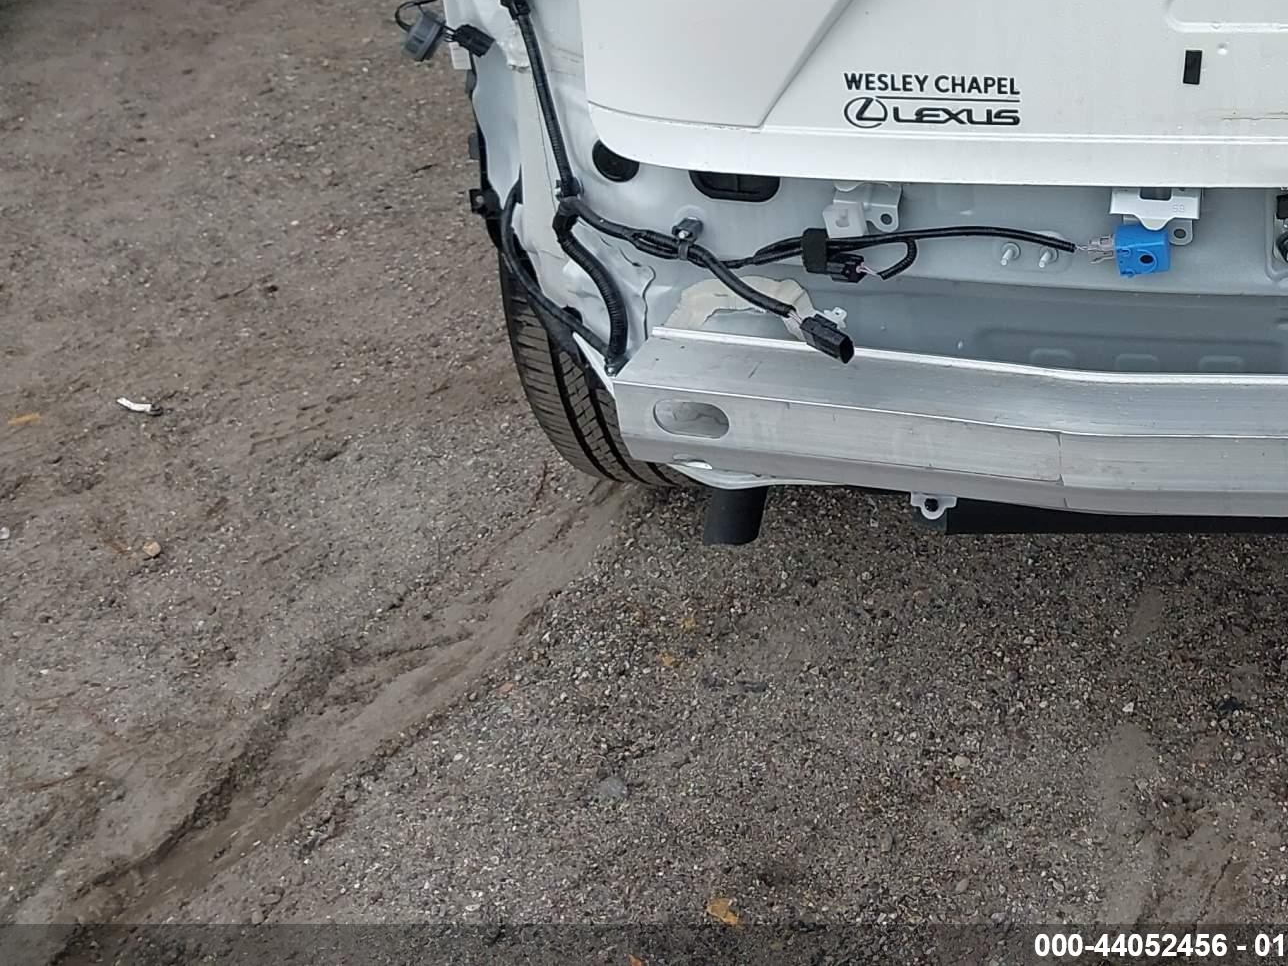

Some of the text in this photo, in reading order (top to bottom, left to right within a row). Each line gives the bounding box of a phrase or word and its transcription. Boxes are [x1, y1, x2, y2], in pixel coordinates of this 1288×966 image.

[844, 72, 1021, 95] WESLEY CHAPEL
[892, 106, 1021, 126] LEXUS
